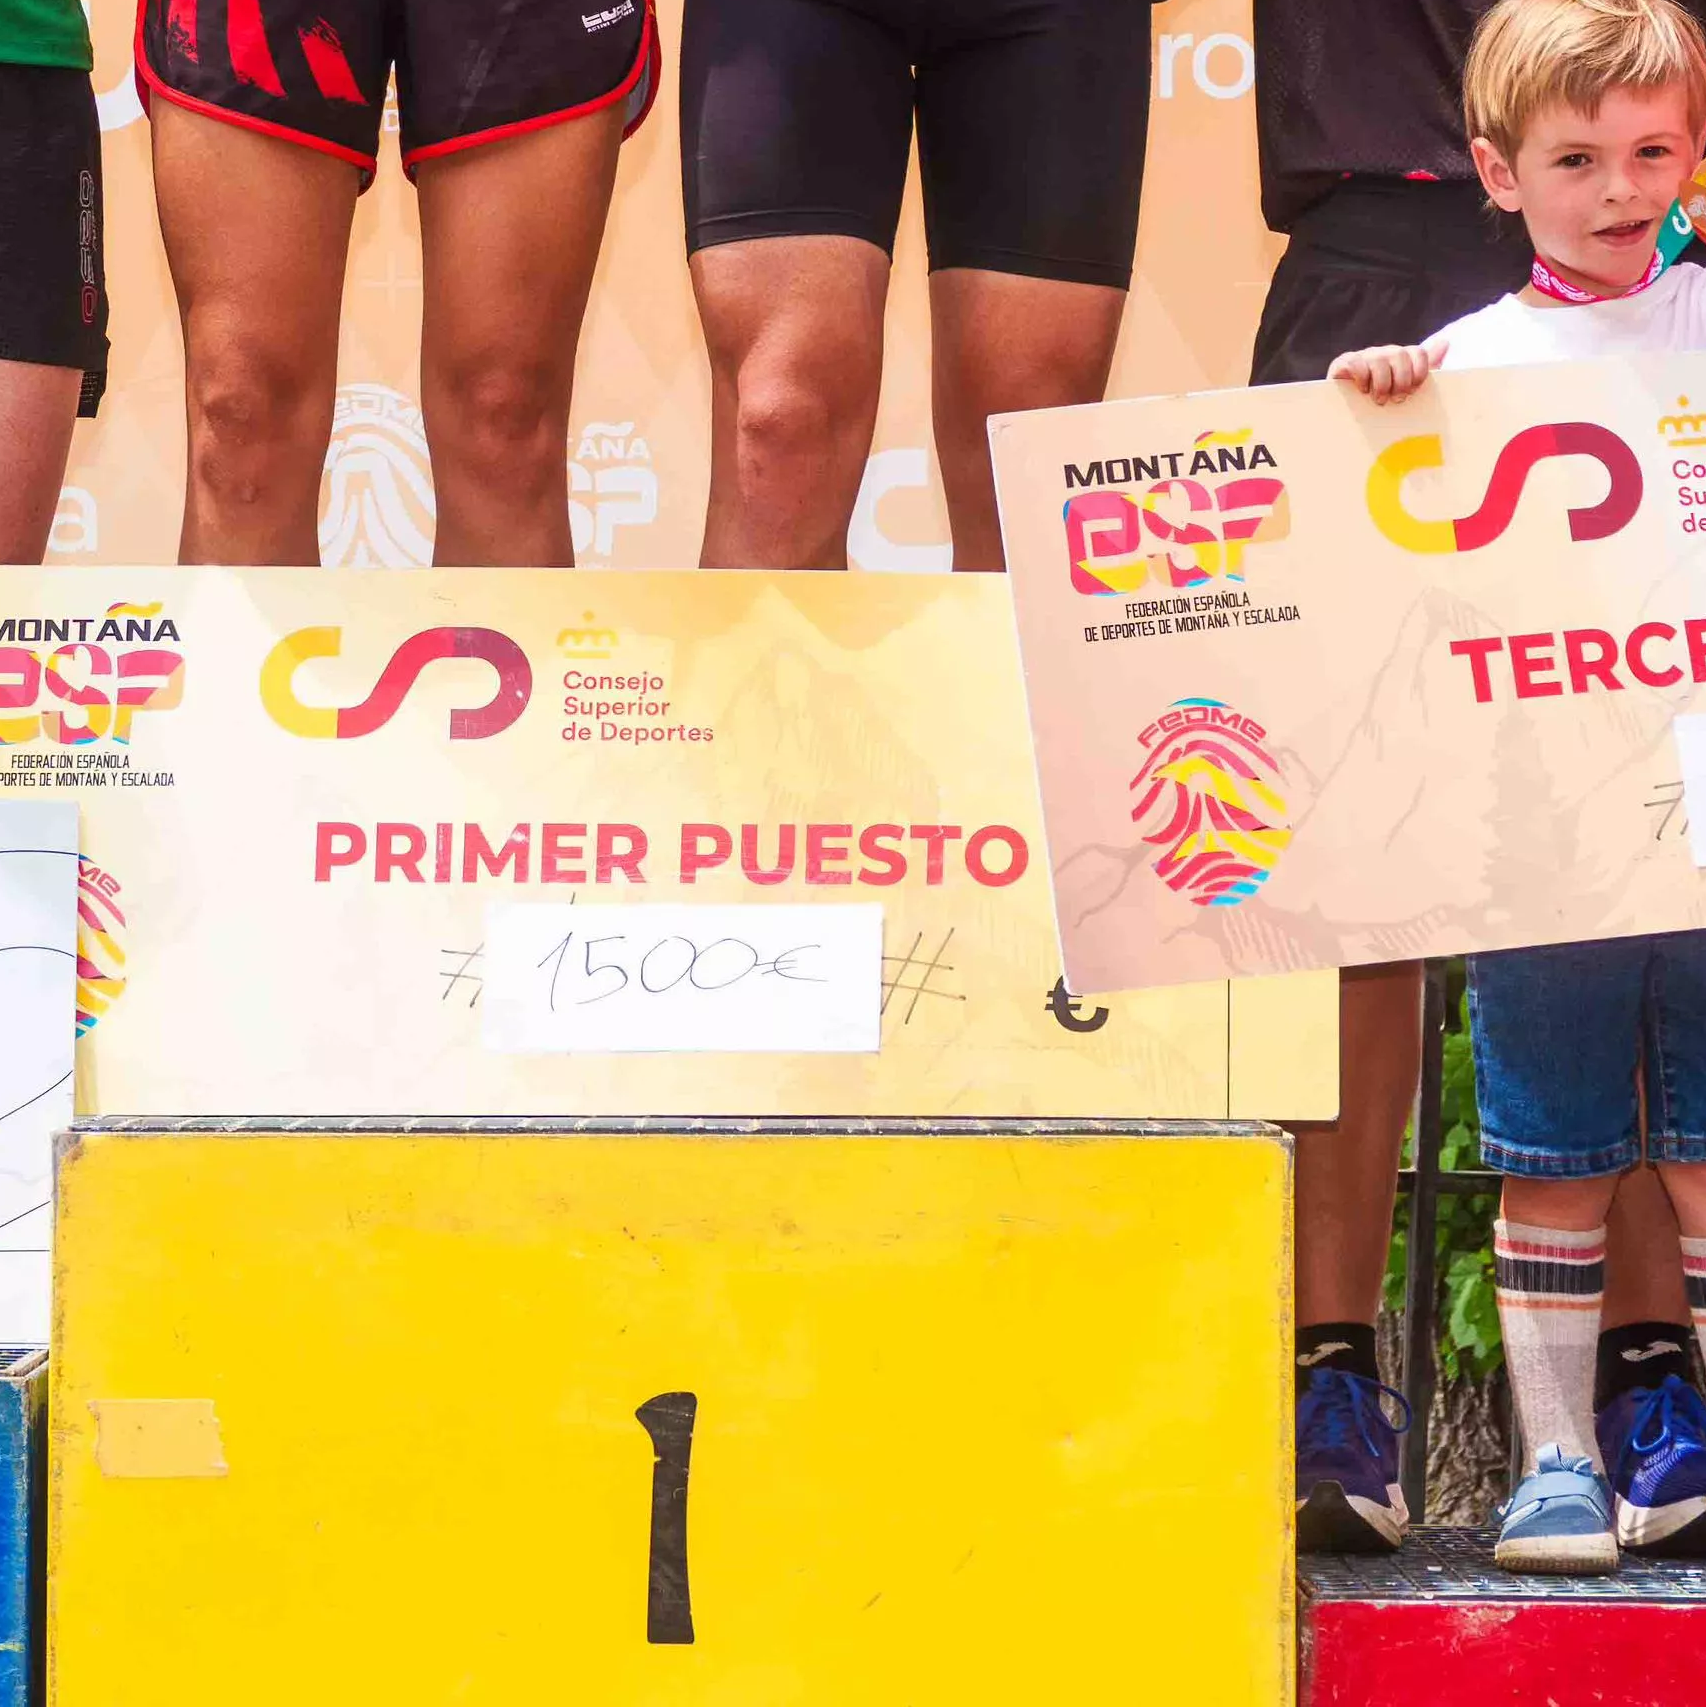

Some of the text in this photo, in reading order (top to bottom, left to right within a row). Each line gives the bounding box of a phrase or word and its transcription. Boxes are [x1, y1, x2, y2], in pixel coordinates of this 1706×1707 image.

[1063, 427, 1279, 490] MONTAÑA
[1124, 592, 1251, 620] FEDERACIÓN ESPAÑOLA
[1083, 604, 1301, 643] DE DEPORTES DE MONTAÑA Y ESCALADA
[562, 670, 664, 695] Consejo
[563, 696, 671, 721] Superior
[562, 721, 715, 746] de Deportes
[11, 751, 130, 770] FEDERACIÓN ESPAÑOLA
[39, 771, 53, 787] DE
[55, 767, 108, 787] MONTAÑA
[110, 771, 118, 786] Y
[121, 771, 175, 787] ESCALADA
[314, 822, 1030, 888] PRIMER PUESTO
[537, 931, 831, 1010] 1500€
[1045, 977, 1110, 1035] €
[635, 1391, 698, 1645] 1
